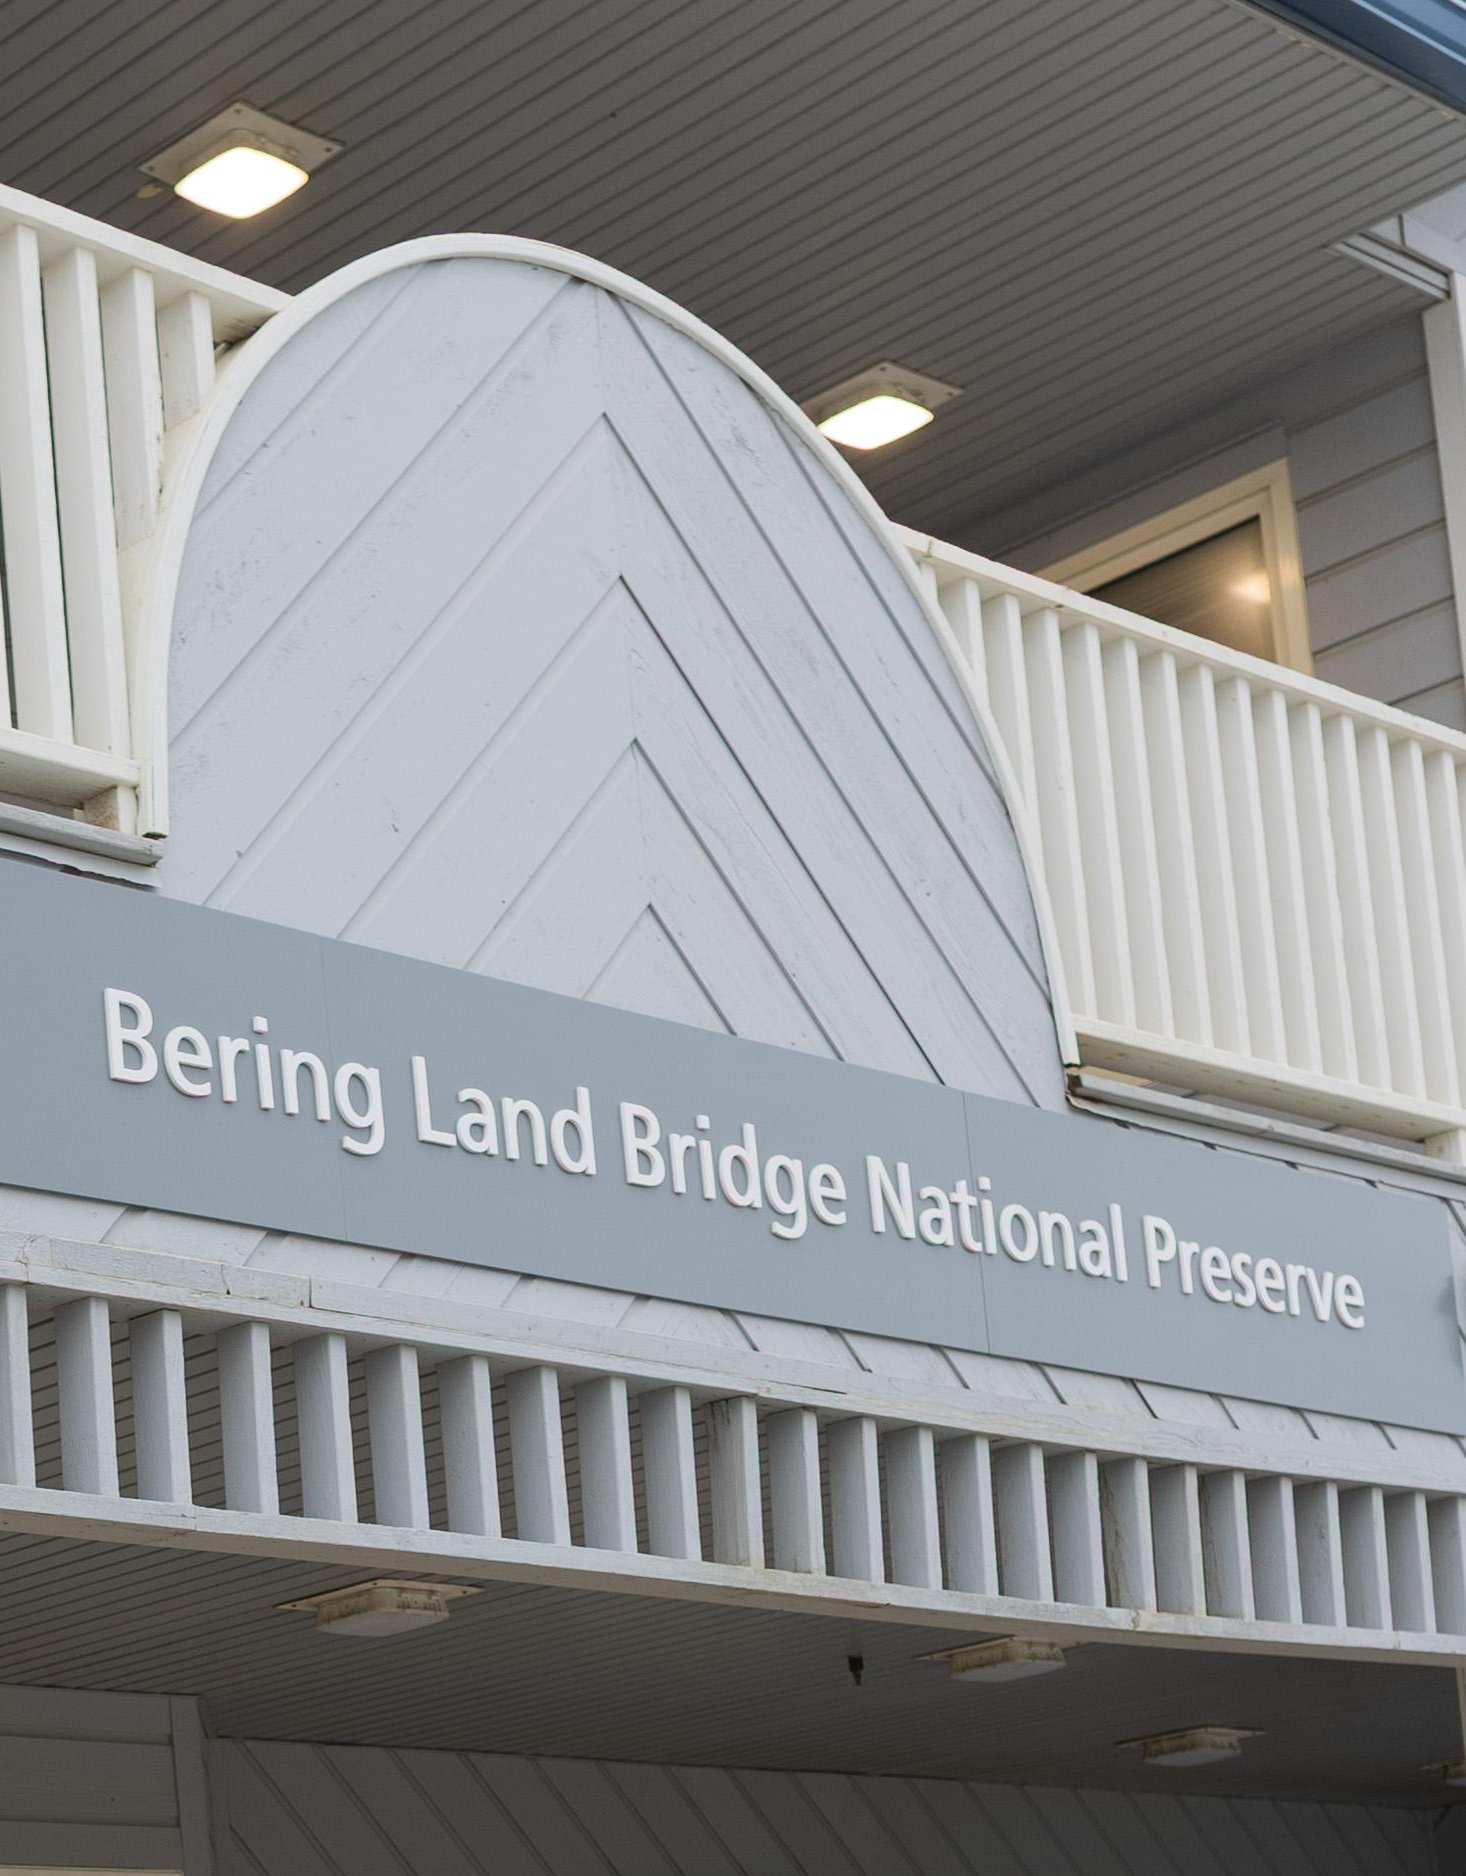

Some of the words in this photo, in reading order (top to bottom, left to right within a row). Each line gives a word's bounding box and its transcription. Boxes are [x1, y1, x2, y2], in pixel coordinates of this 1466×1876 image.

[104, 987, 385, 1156] Bering
[411, 1055, 597, 1176] Land
[620, 1101, 847, 1240] Bridge
[867, 1155, 1128, 1282] National
[1143, 1215, 1365, 1330] Preserve
